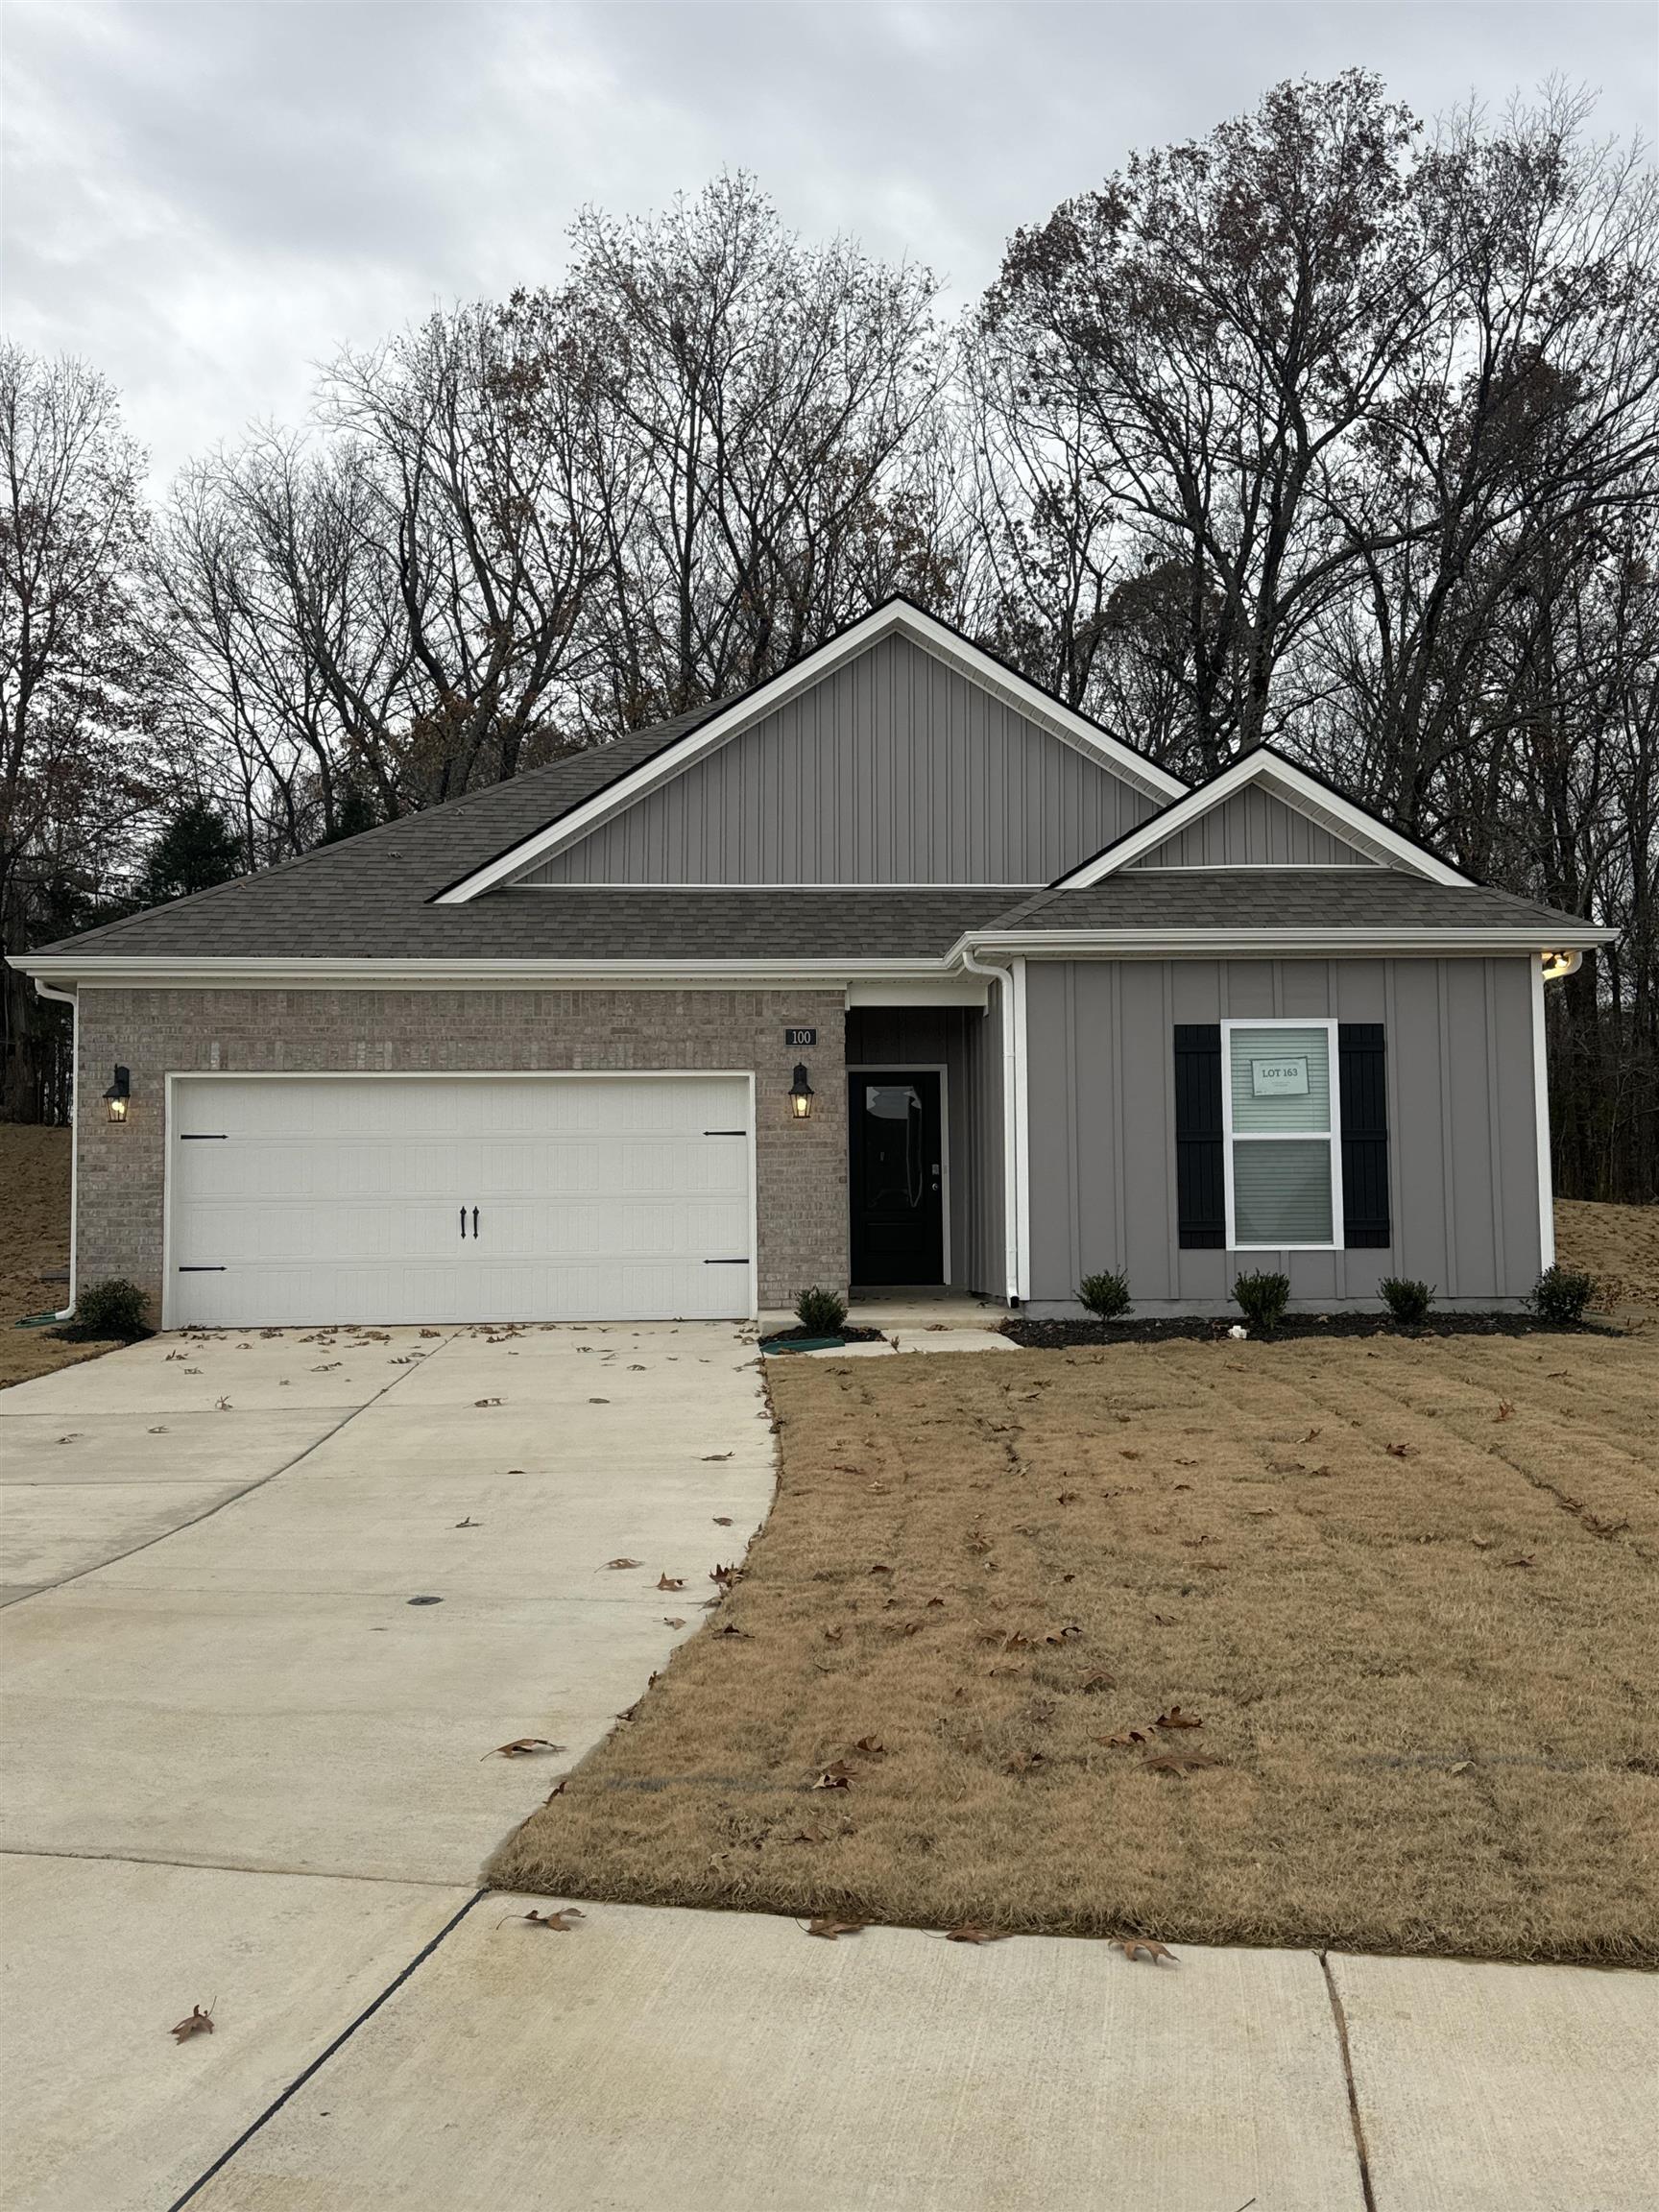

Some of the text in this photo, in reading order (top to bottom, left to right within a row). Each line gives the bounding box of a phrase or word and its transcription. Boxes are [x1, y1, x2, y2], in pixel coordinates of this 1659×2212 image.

[792, 1030, 811, 1044] 100
[1262, 1068, 1298, 1078] LOT 163
